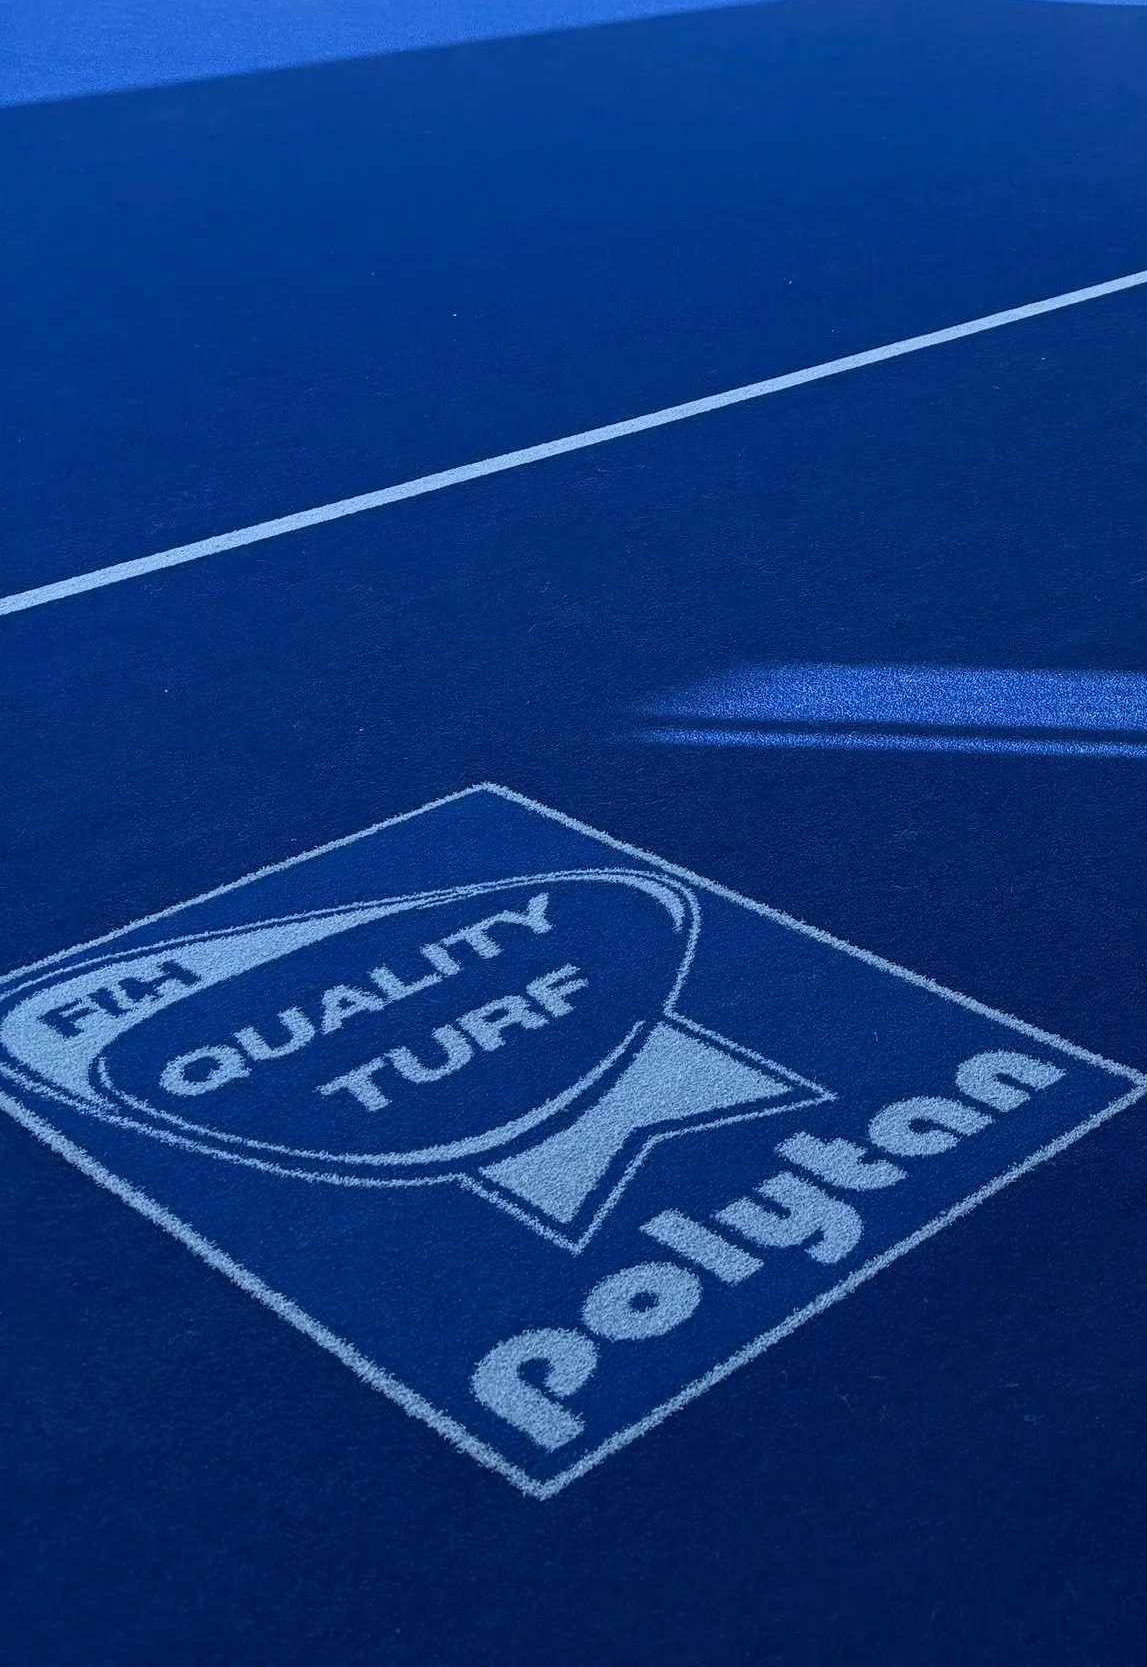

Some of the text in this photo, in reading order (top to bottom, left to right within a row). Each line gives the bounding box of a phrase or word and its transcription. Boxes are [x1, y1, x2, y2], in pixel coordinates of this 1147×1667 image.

[36, 959, 201, 1039] FIH
[158, 892, 553, 1097] QUALITY
[313, 962, 589, 1113] TURF
[470, 1049, 1067, 1449] polytan
